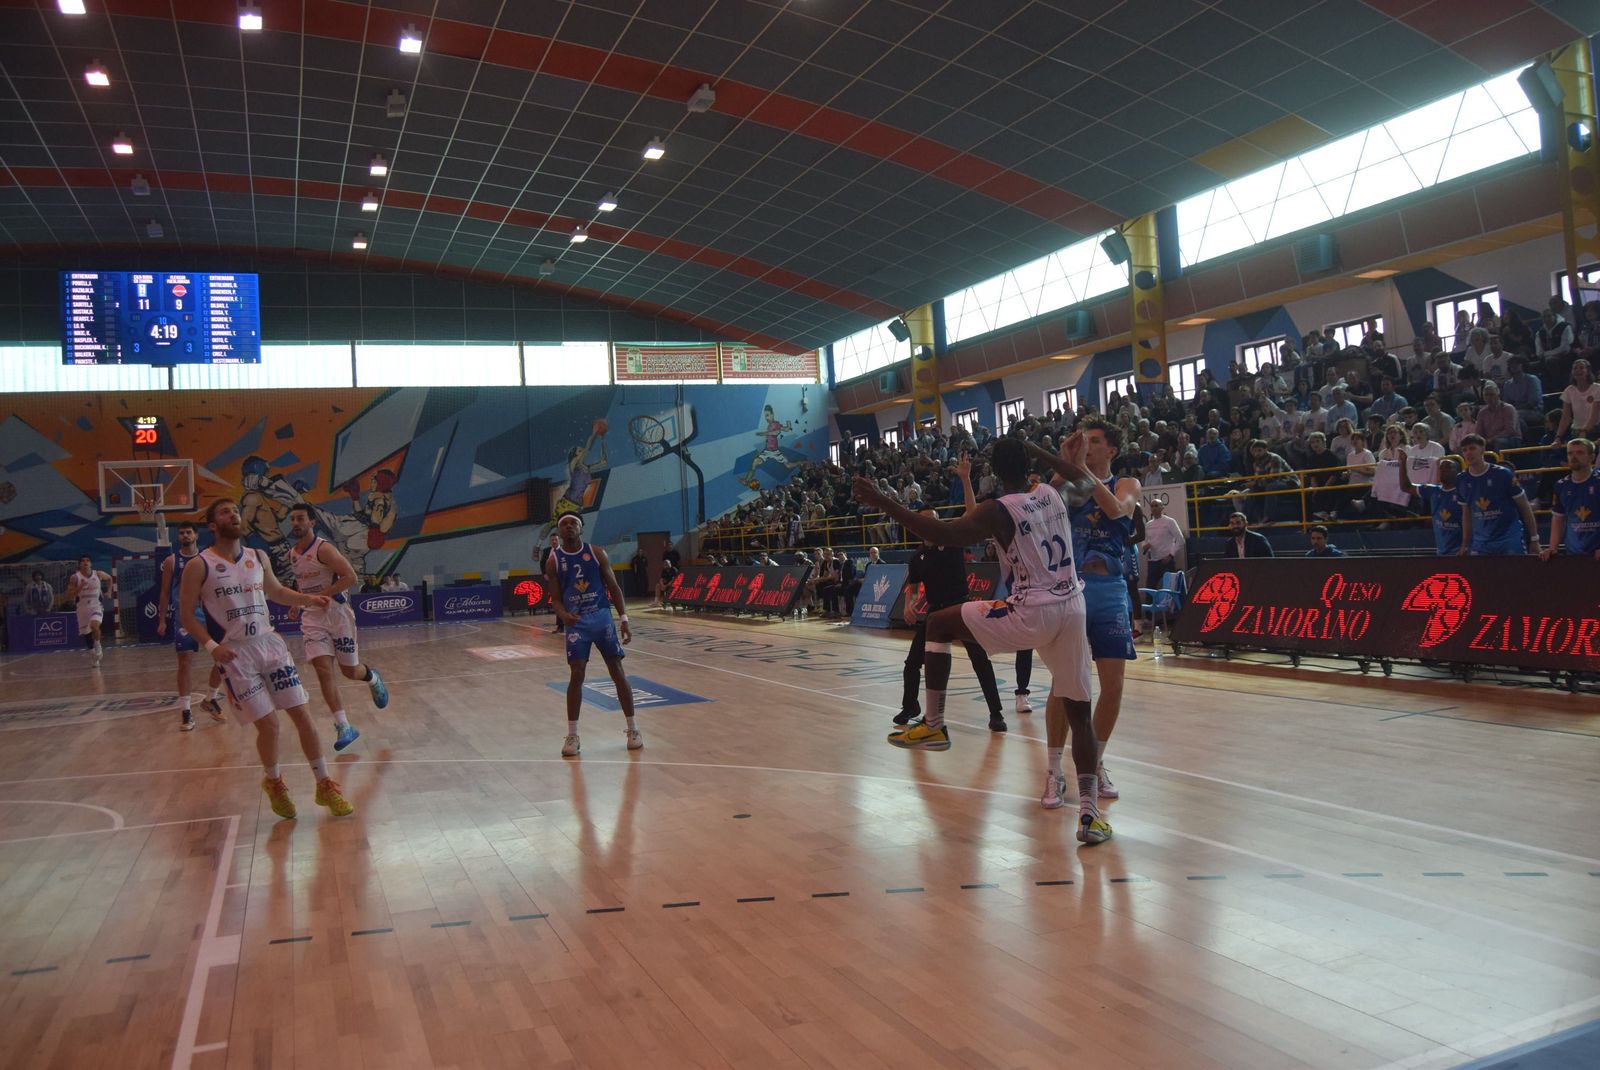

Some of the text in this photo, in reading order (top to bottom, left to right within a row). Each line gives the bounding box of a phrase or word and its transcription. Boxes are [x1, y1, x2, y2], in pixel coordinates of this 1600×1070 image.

[138, 299, 150, 310] 11
[176, 299, 183, 310] 9
[151, 325, 178, 339] 4:19
[134, 343, 140, 353] 3
[186, 343, 193, 353] 3
[137, 416, 157, 424] 4:19
[135, 429, 157, 444] 20
[1041, 534, 1072, 573] 22
[573, 564, 584, 578] 2
[214, 584, 242, 598] Flexi
[1320, 573, 1383, 608] QUESO
[366, 598, 407, 611] FERRERO
[39, 620, 63, 632] AC
[245, 621, 257, 637] 16
[1232, 605, 1371, 641] ZAMORANO
[273, 677, 302, 692] JOHN
